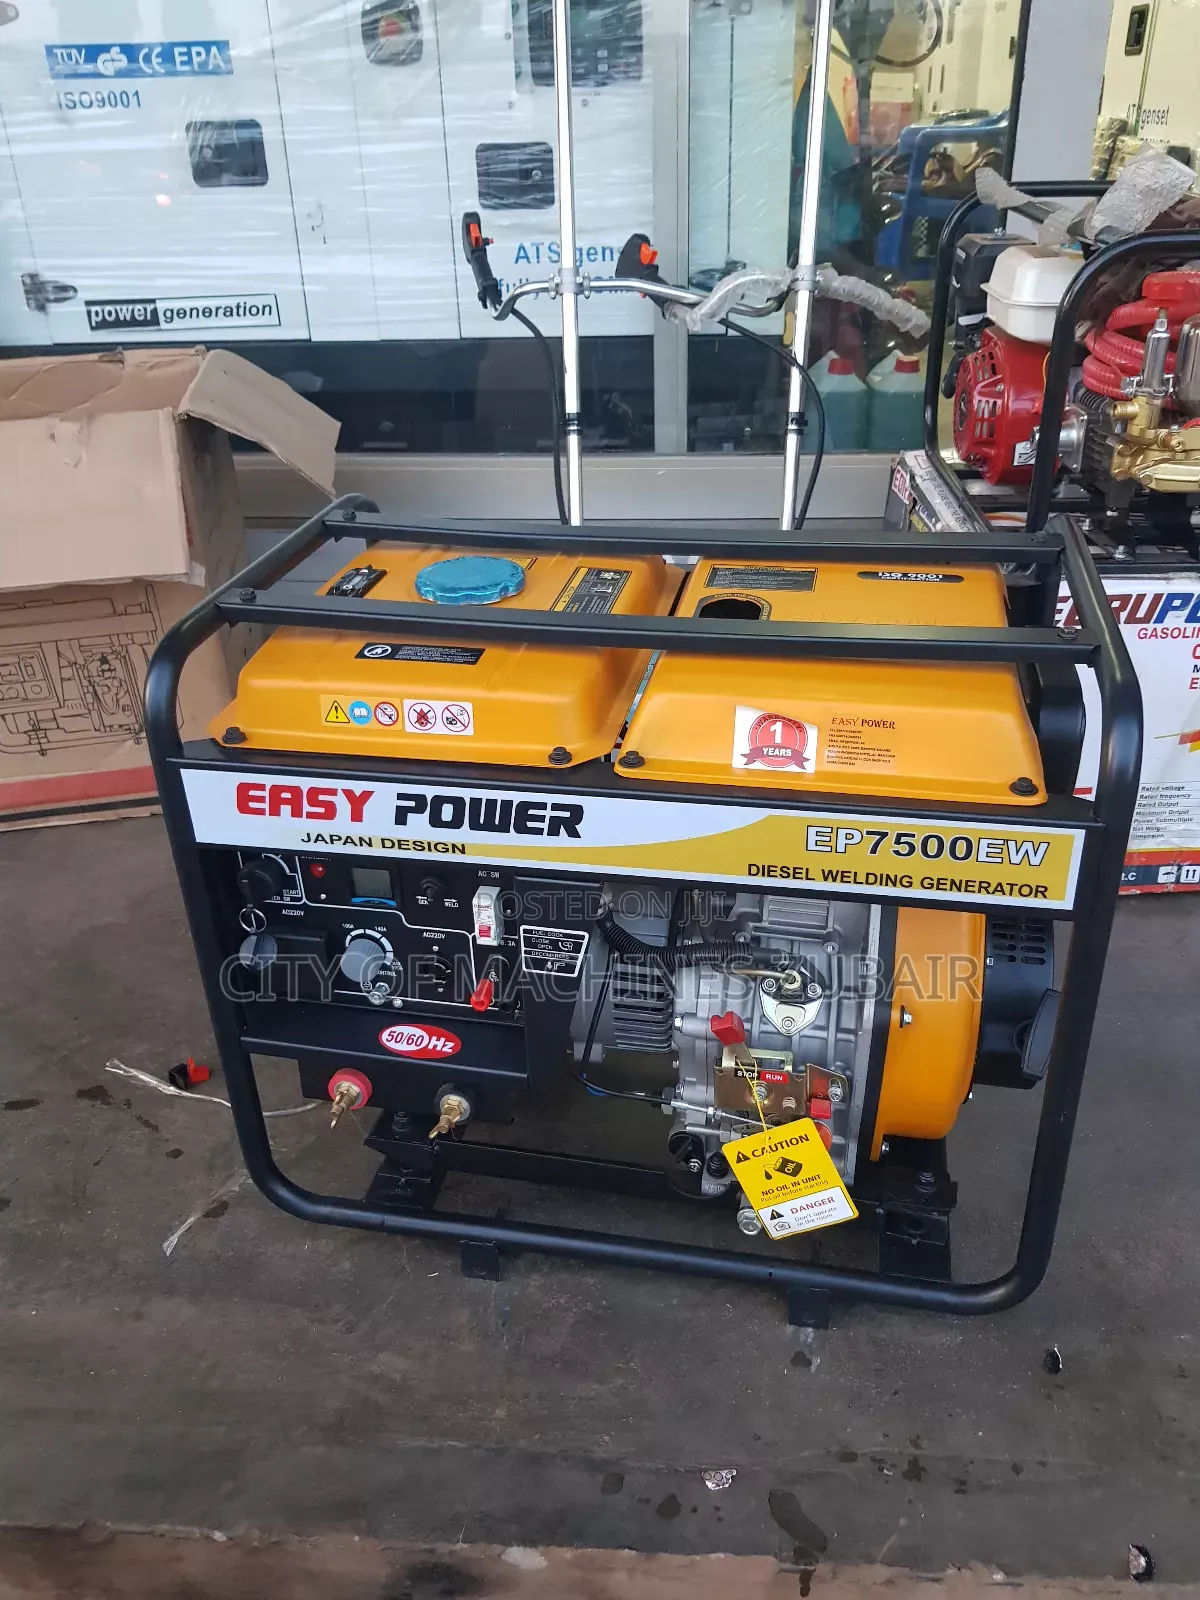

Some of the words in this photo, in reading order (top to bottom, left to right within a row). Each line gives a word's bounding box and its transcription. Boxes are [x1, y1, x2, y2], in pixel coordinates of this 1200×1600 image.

[173, 45, 226, 72] EPA
[57, 89, 142, 110] ISO9001
[90, 303, 155, 327] power
[163, 301, 273, 323] generation
[769, 721, 783, 744] 1
[831, 716, 860, 727] EASY
[861, 718, 896, 730] POWER
[762, 747, 792, 757] YEARS
[236, 781, 376, 823] EASY
[394, 791, 585, 839] POWER
[300, 831, 374, 849] JAPAN
[380, 836, 467, 855] DESIGN
[804, 824, 1049, 867] EP7500EW
[747, 862, 816, 882] DIESEL
[821, 868, 914, 889] WELDING
[918, 875, 1049, 900] GENERATOR
[385, 1030, 425, 1047] 50/60
[427, 1035, 455, 1053] Hz
[736, 1070, 758, 1079] STOP
[765, 1073, 783, 1082] RUN
[751, 1133, 810, 1158] CAUTION
[785, 1161, 797, 1174] OIL
[760, 1195, 772, 1203] Put
[782, 1187, 803, 1198] before
[803, 1179, 829, 1192] starting
[761, 1188, 775, 1197] NO
[775, 1184, 791, 1193] OIL
[791, 1180, 801, 1188] IN
[801, 1173, 822, 1185] UNIT
[789, 1196, 836, 1215] DANGER
[812, 1206, 838, 1218] operate
